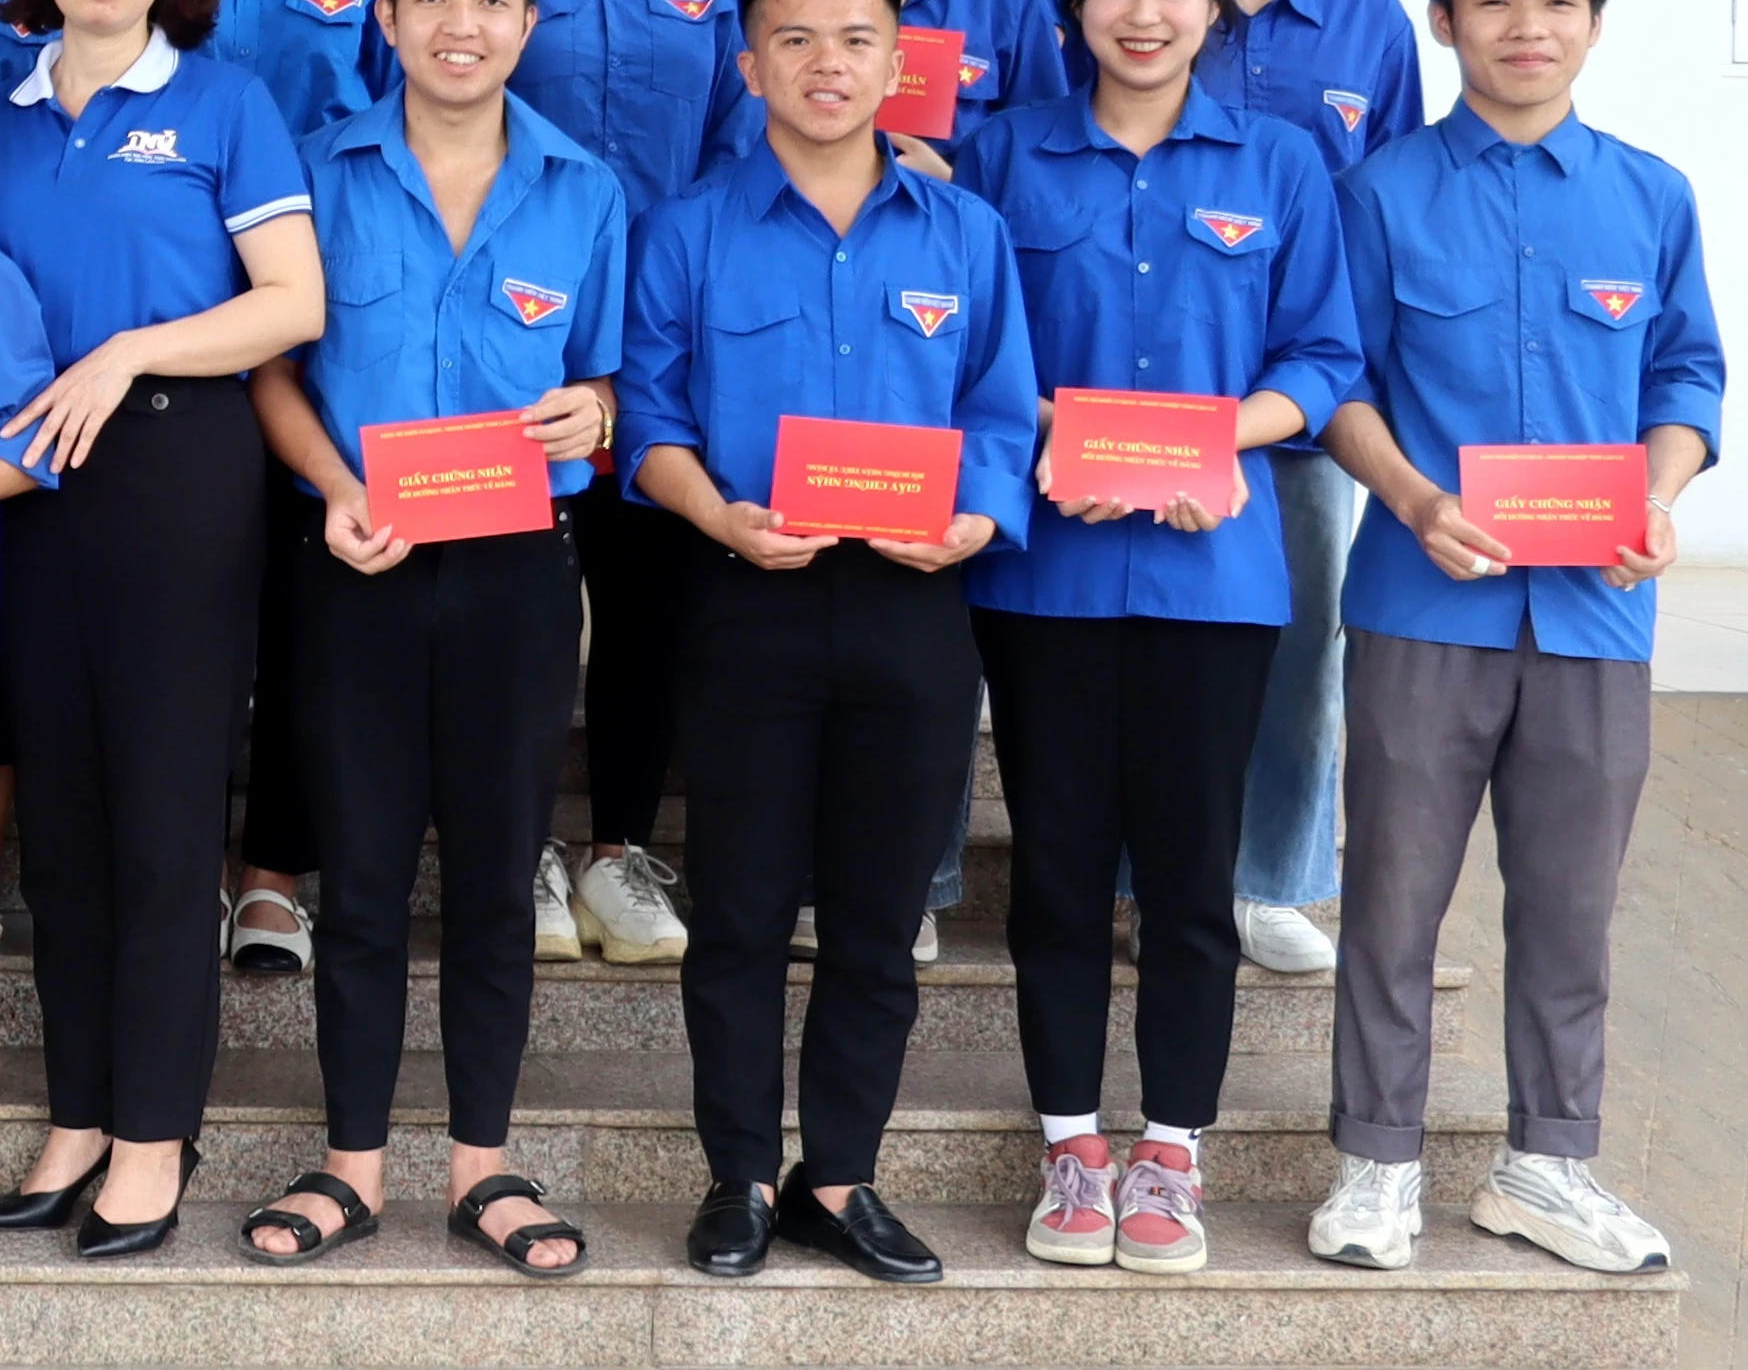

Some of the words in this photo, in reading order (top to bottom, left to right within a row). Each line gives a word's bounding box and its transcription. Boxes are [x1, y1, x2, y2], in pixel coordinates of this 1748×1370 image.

[1084, 437, 1115, 452] GIẤY
[1117, 439, 1162, 455] CHỨNG
[1165, 442, 1200, 458] NHẬN
[398, 471, 429, 487] GIẤY
[431, 467, 475, 484] CHỨNG
[477, 463, 512, 479] NHẬN
[1495, 496, 1526, 510] GIẤY
[1529, 496, 1573, 510] CHỨNG
[1577, 496, 1611, 510] NHẬN
